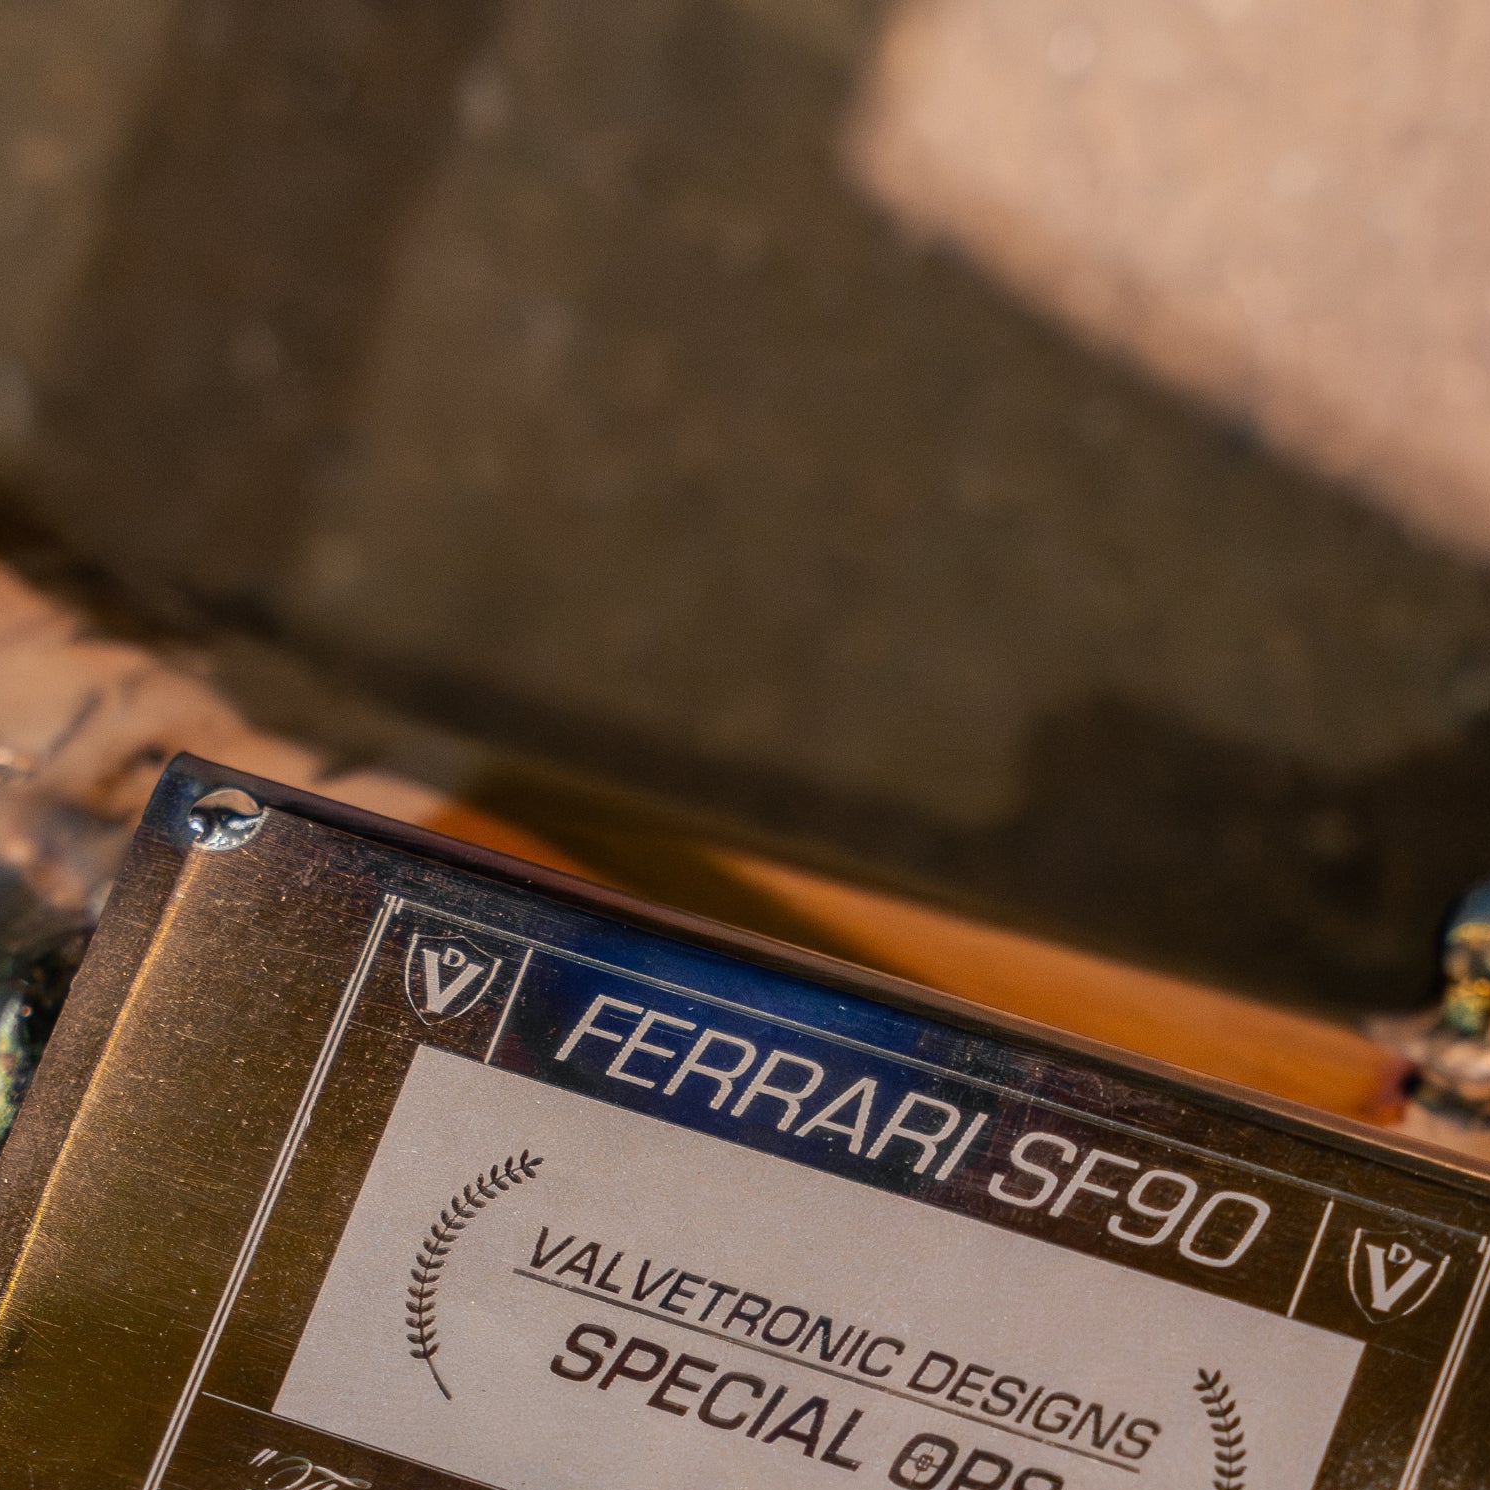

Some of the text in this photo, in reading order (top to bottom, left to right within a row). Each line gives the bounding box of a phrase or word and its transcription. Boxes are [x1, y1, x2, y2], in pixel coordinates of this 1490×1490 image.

[554, 993, 1272, 1270] FERRARI SF90
[526, 1225, 1162, 1461] VALVETRONIC DESIGNS
[548, 1321, 865, 1473] SPECIAL
